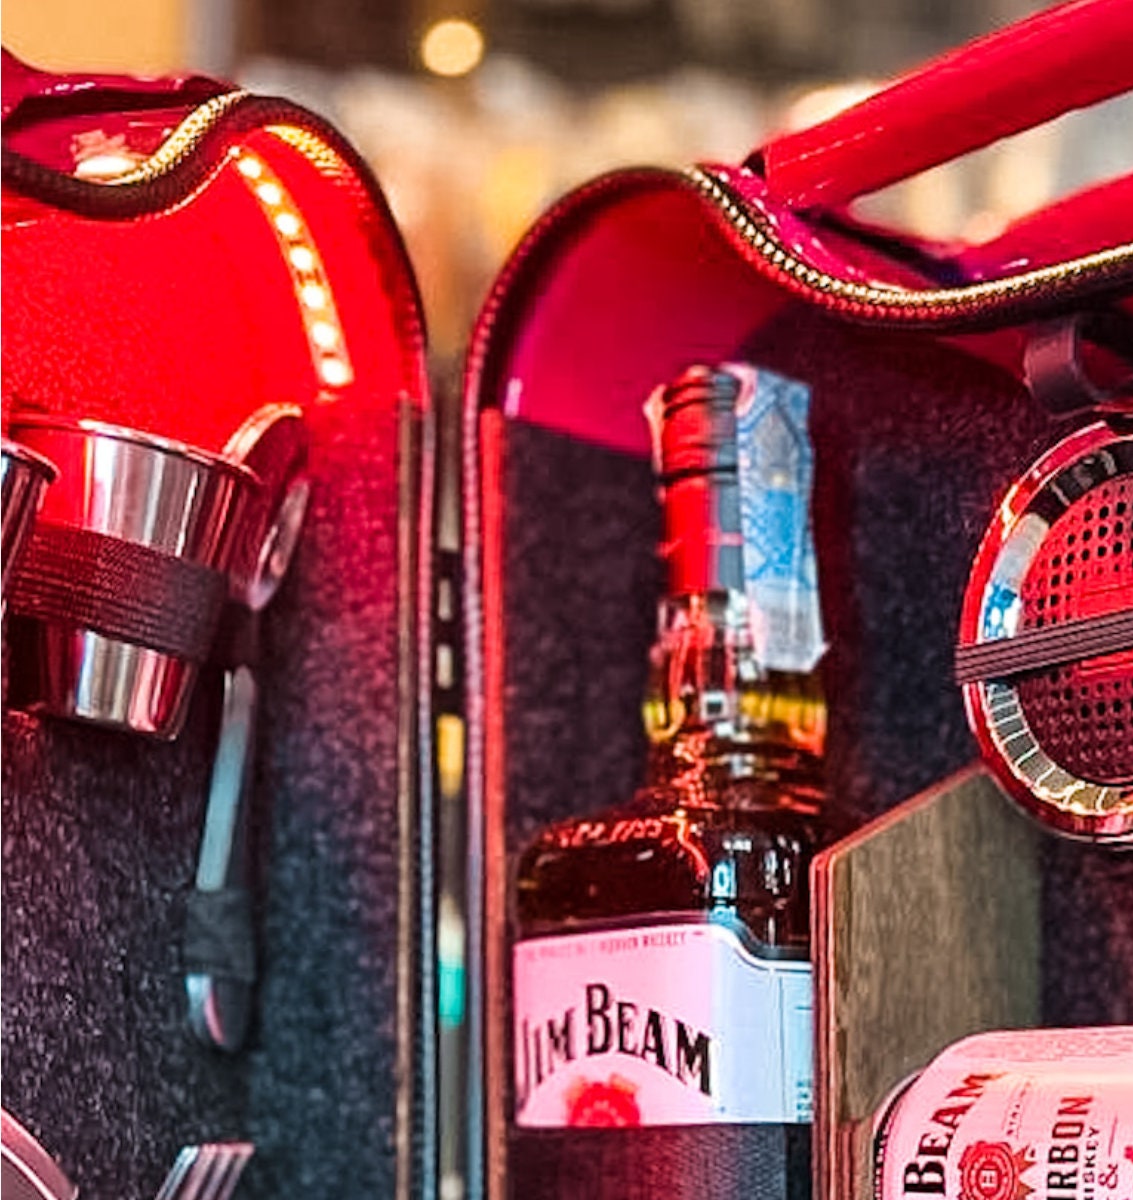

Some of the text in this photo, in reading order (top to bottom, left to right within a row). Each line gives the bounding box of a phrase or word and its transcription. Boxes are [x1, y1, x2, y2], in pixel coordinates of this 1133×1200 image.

[516, 983, 713, 1111] JIM BEAM
[903, 1071, 1005, 1197] BEAM
[1099, 1163, 1119, 1191] &
